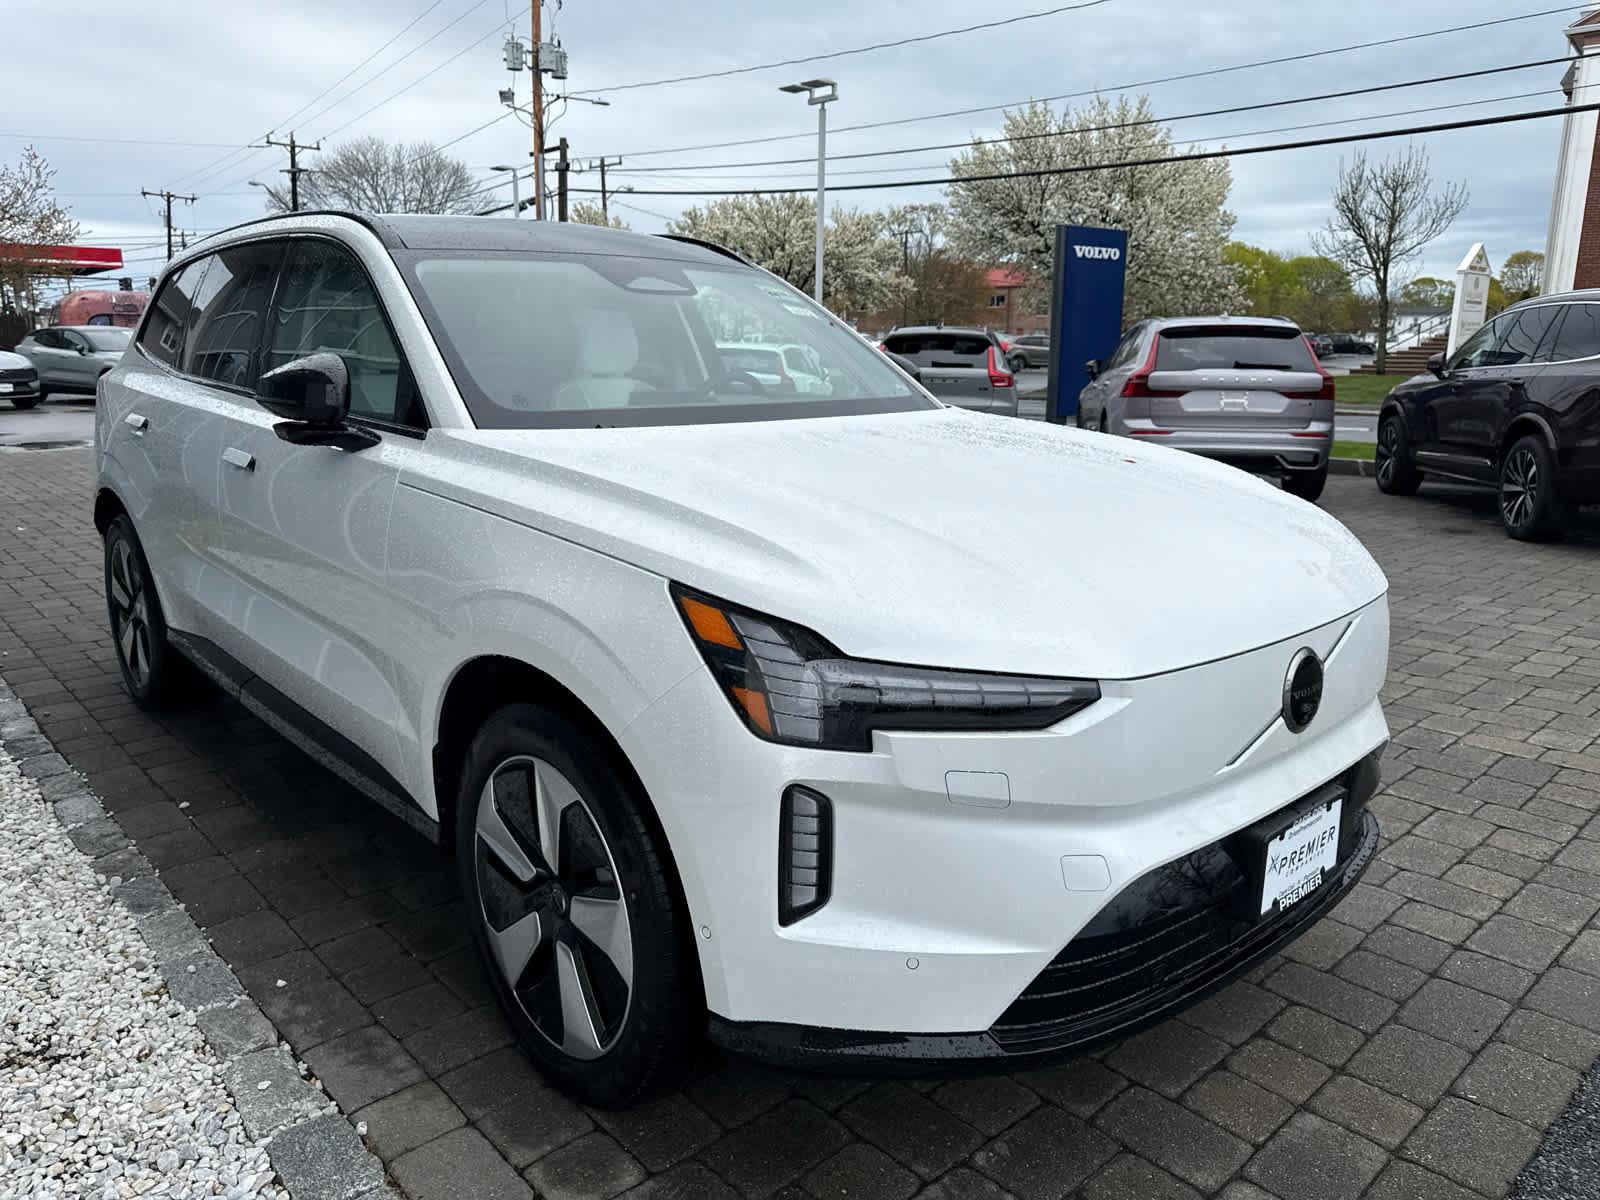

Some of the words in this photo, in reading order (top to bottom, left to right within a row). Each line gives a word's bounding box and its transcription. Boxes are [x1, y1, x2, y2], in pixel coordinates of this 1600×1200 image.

[1073, 245, 1120, 260] VOLVO
[1278, 825, 1336, 875] PREMIER
[1279, 874, 1322, 912] PREMIER
